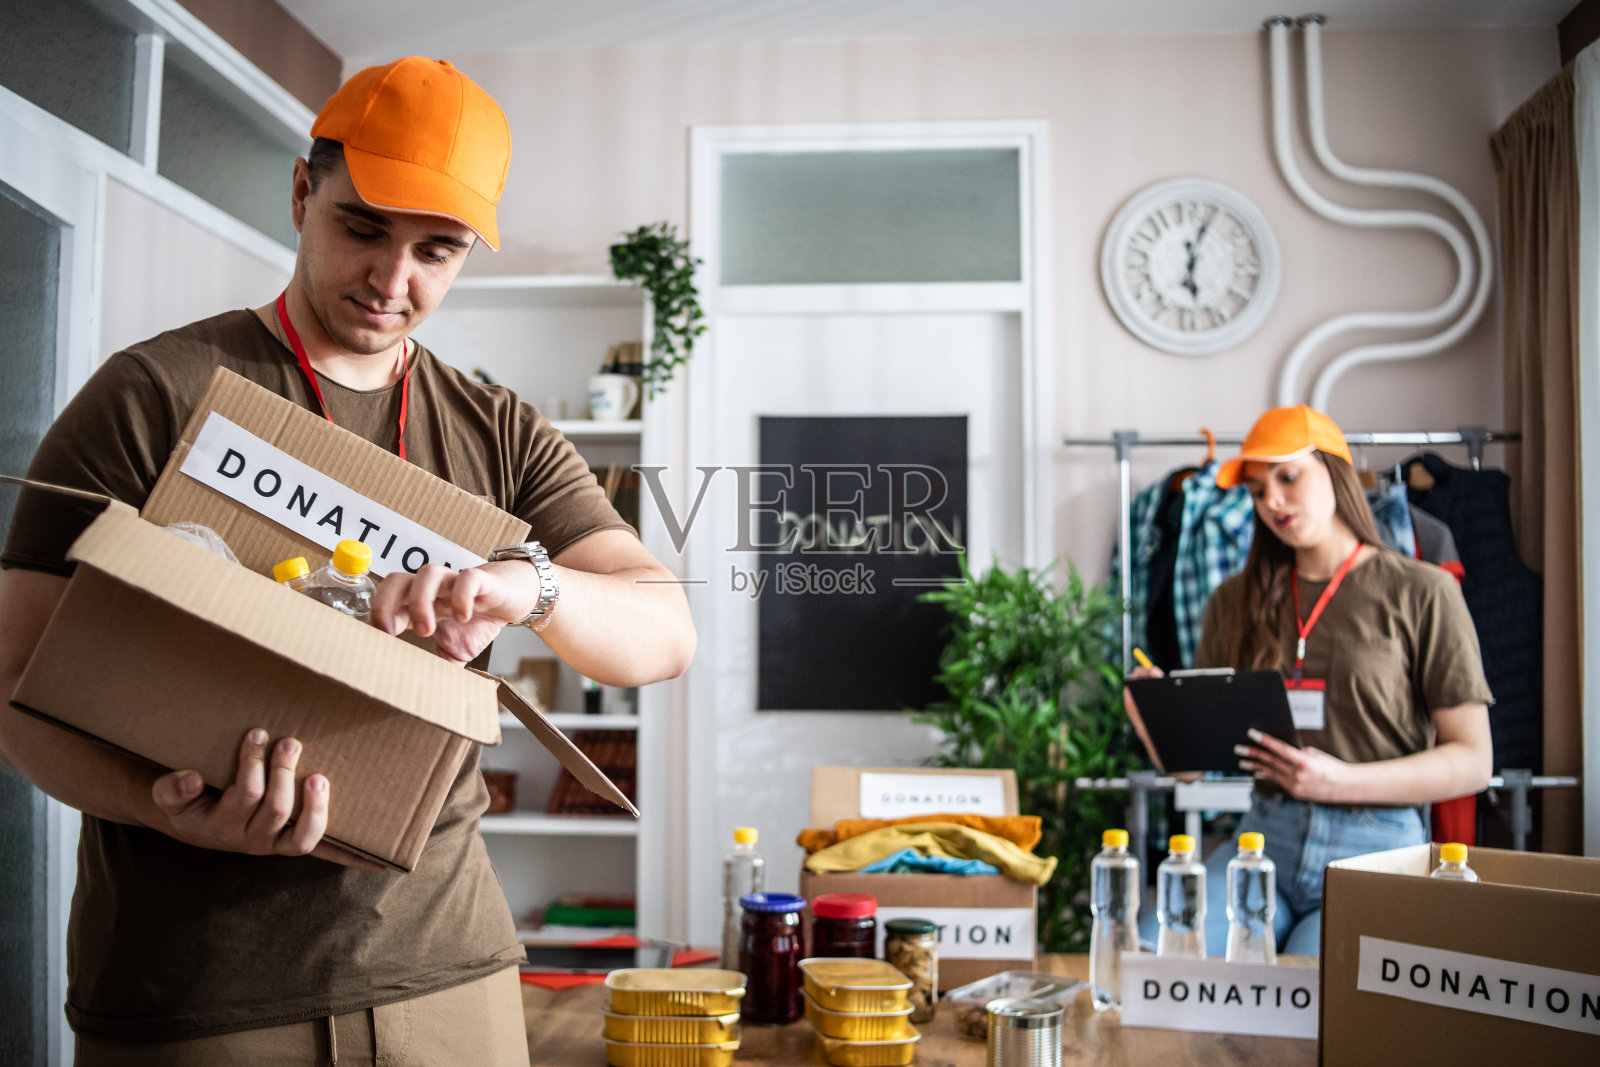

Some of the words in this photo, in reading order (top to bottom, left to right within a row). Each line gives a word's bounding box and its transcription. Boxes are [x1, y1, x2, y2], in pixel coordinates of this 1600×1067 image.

[216, 448, 462, 574] DONATIO
[881, 793, 981, 805] DONATION
[1381, 957, 1600, 1020] DONATION
